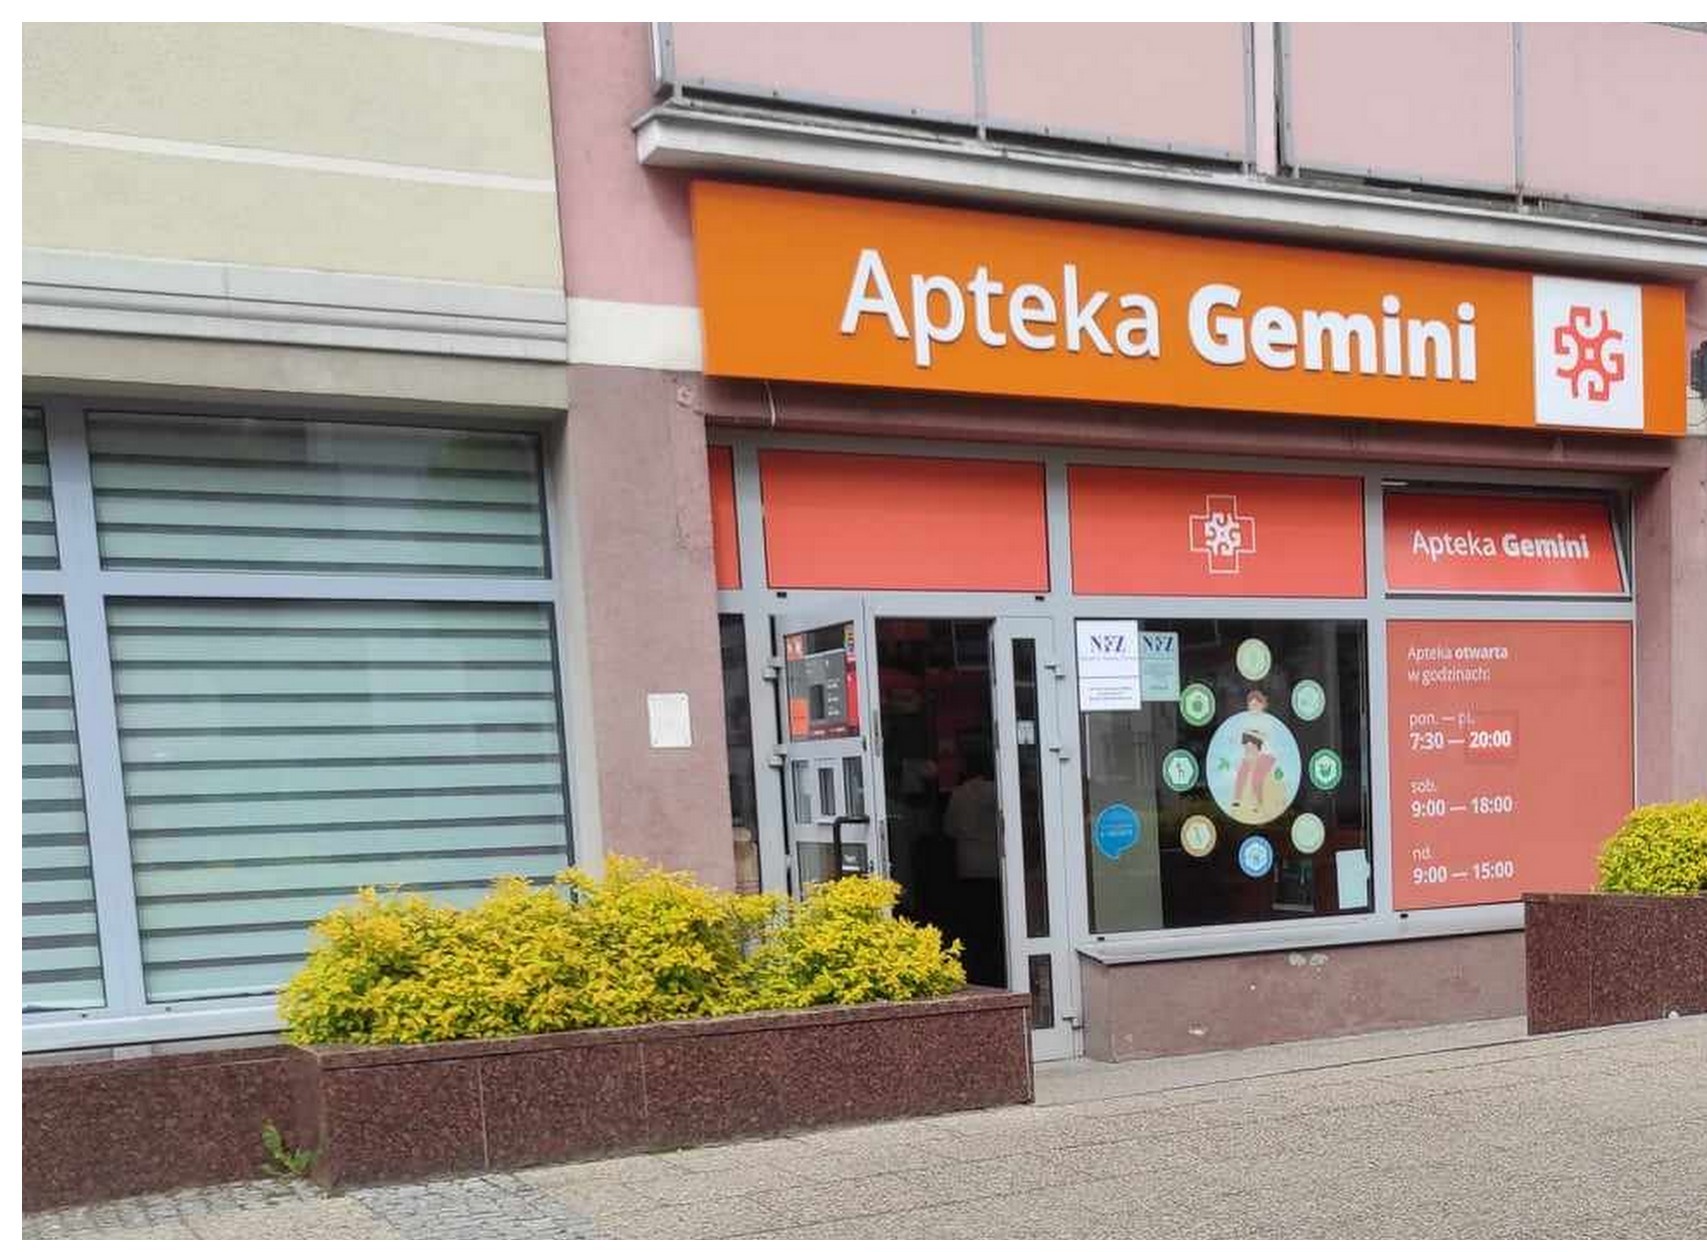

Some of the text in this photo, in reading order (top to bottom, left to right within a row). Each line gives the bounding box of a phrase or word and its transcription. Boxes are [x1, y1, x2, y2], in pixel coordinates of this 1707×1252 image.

[841, 249, 1477, 382] Apteka Gemini
[1412, 530, 1590, 561] Apteka Gemini
[1090, 635, 1125, 652] NFZ
[1142, 635, 1174, 652] NFZ
[1408, 646, 1508, 662] Apteka otwarta
[1407, 671, 1418, 682] w
[1409, 732, 1444, 751] 7:30
[1469, 729, 1512, 749] 20:00
[1411, 799, 1446, 818] 9:00
[1471, 796, 1513, 815] 18:00
[1413, 866, 1448, 885] 9:00
[1473, 861, 1514, 881] 15:00
